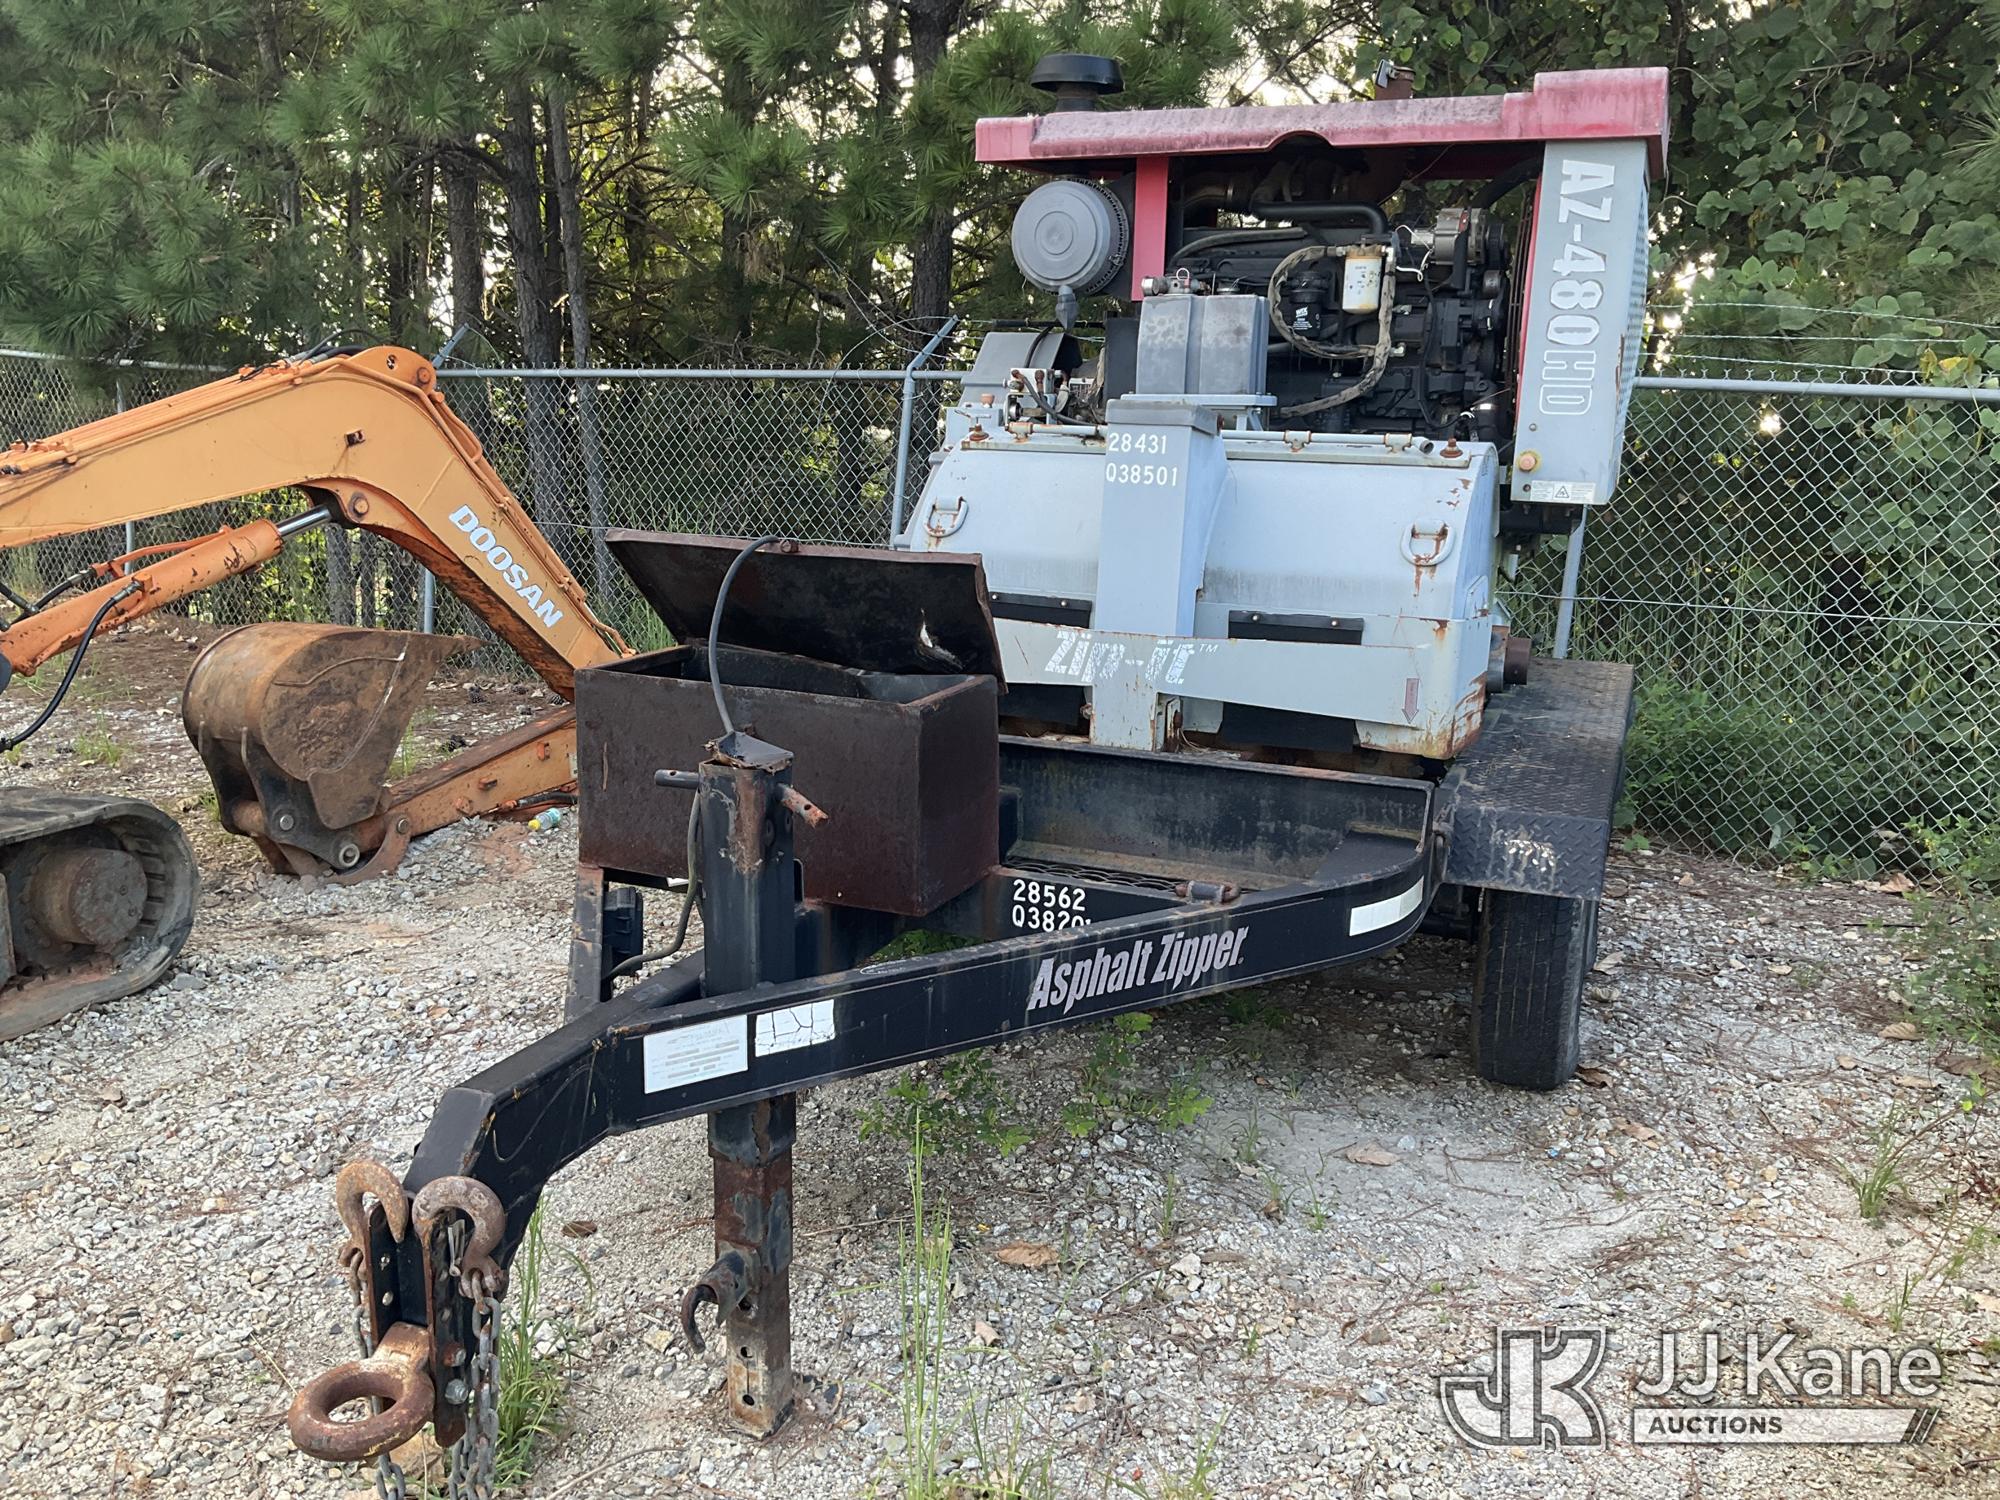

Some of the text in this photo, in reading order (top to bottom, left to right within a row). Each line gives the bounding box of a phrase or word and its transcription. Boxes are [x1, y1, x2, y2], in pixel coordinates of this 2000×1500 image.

[1538, 159, 1616, 416] AZ-480HD
[1108, 432, 1168, 455] 28431
[1106, 462, 1178, 487] Q38501
[448, 504, 564, 628] DOOSAN
[1013, 879, 1086, 912] 28562
[1026, 940, 1153, 1015] Asphalt
